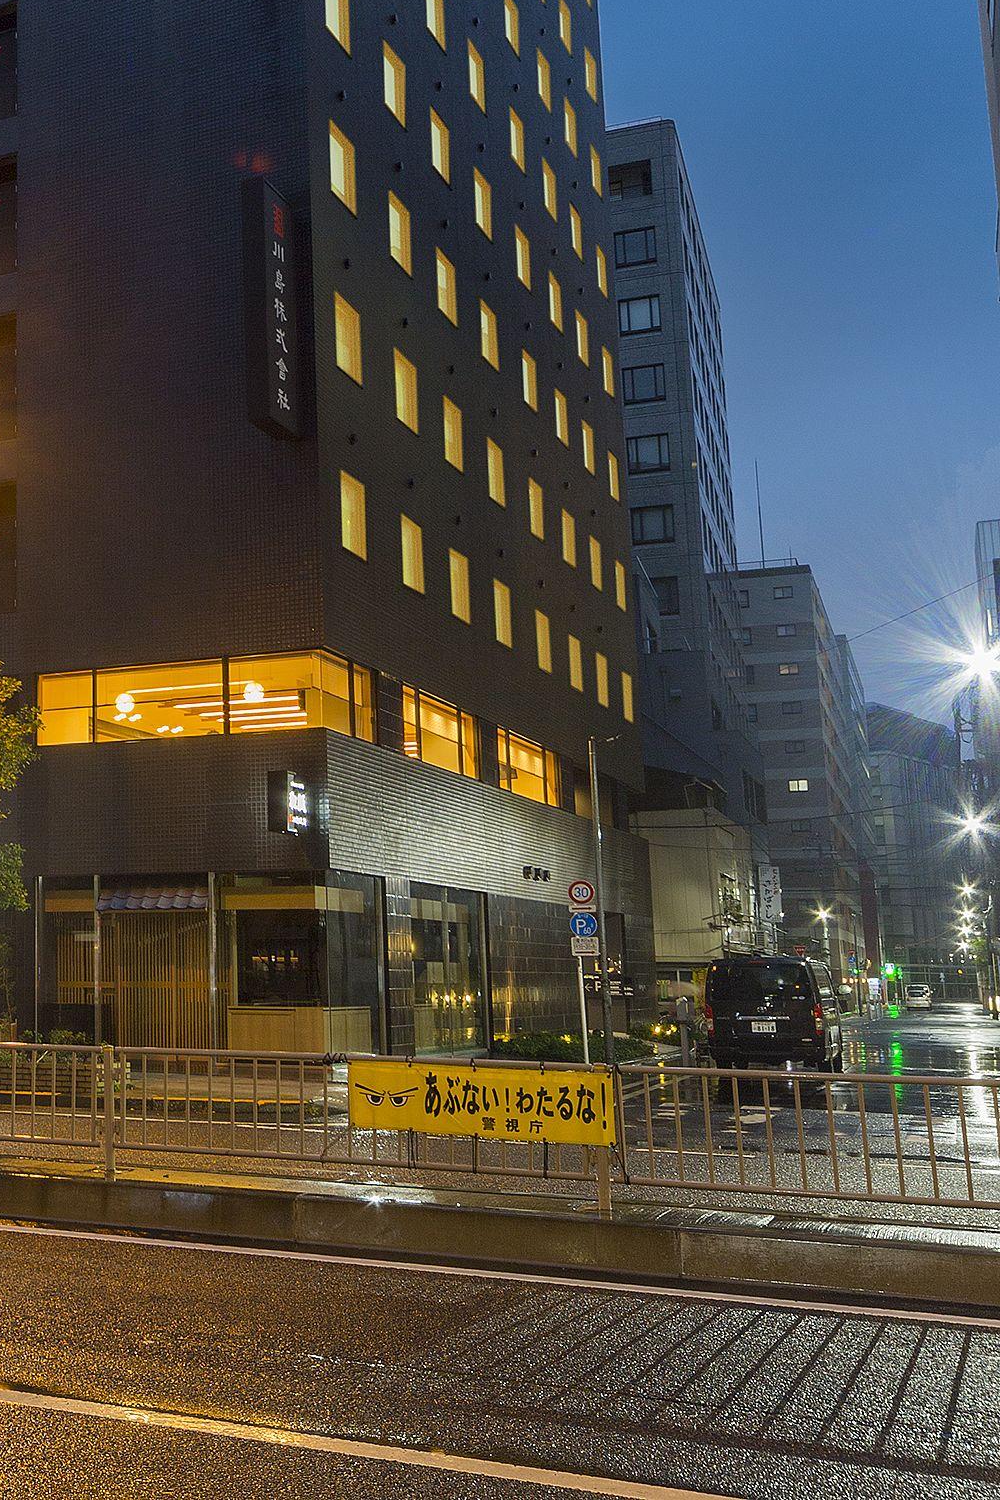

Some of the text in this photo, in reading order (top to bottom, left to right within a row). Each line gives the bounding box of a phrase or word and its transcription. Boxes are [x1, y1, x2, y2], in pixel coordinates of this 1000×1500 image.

[574, 887, 589, 898] 30
[575, 919, 586, 935] P
[481, 1116, 544, 1134] 警視庁
